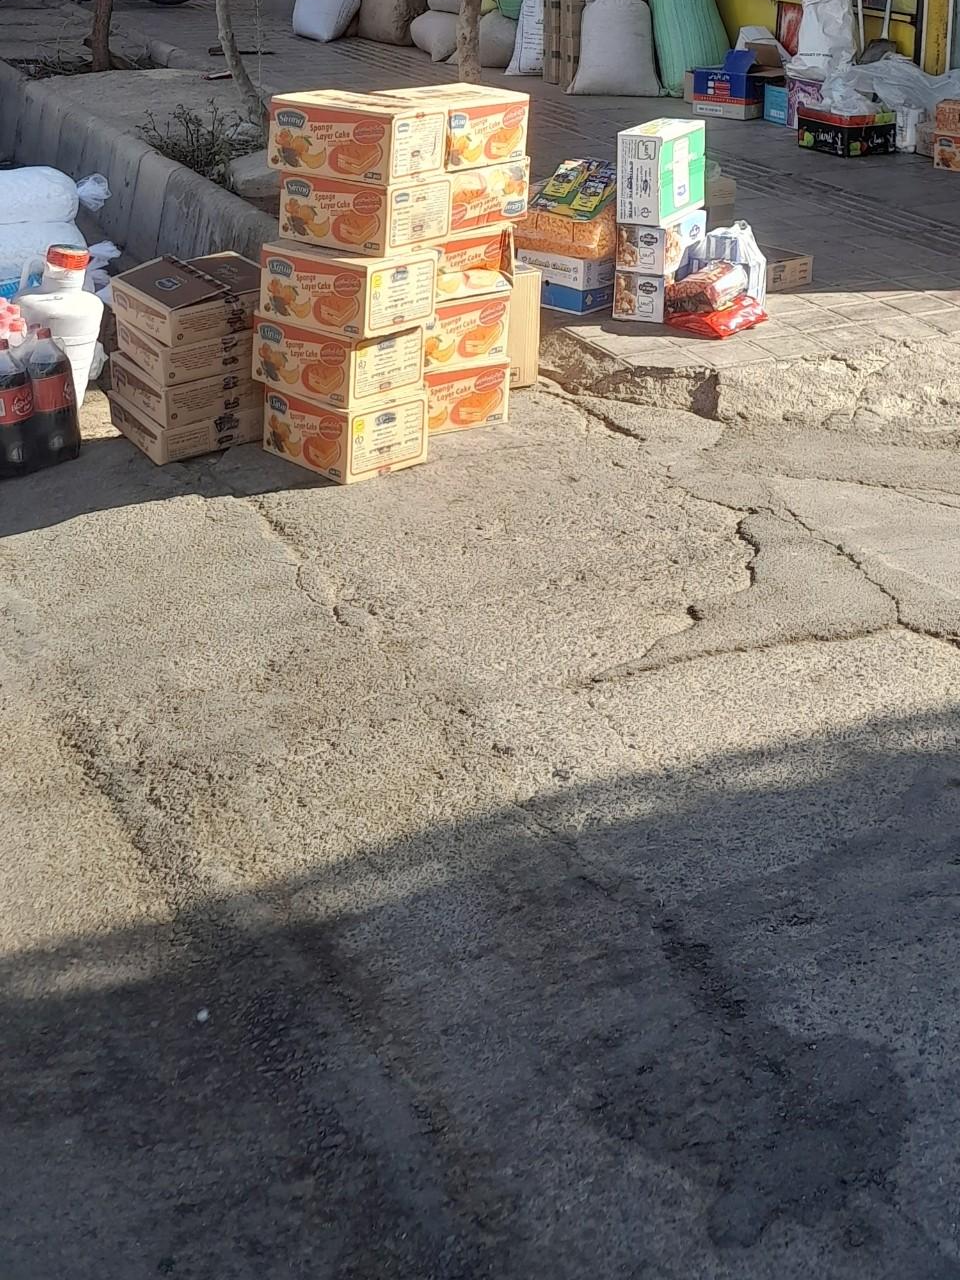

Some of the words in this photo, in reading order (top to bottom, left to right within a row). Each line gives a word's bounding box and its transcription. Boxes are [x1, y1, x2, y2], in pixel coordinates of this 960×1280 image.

[310, 123, 333, 133] Sponge
[316, 131, 333, 141] Layer
[334, 130, 350, 139] Cake
[430, 384, 454, 396] Sponge
[437, 392, 455, 402] Layer
[456, 385, 471, 395] Cake
